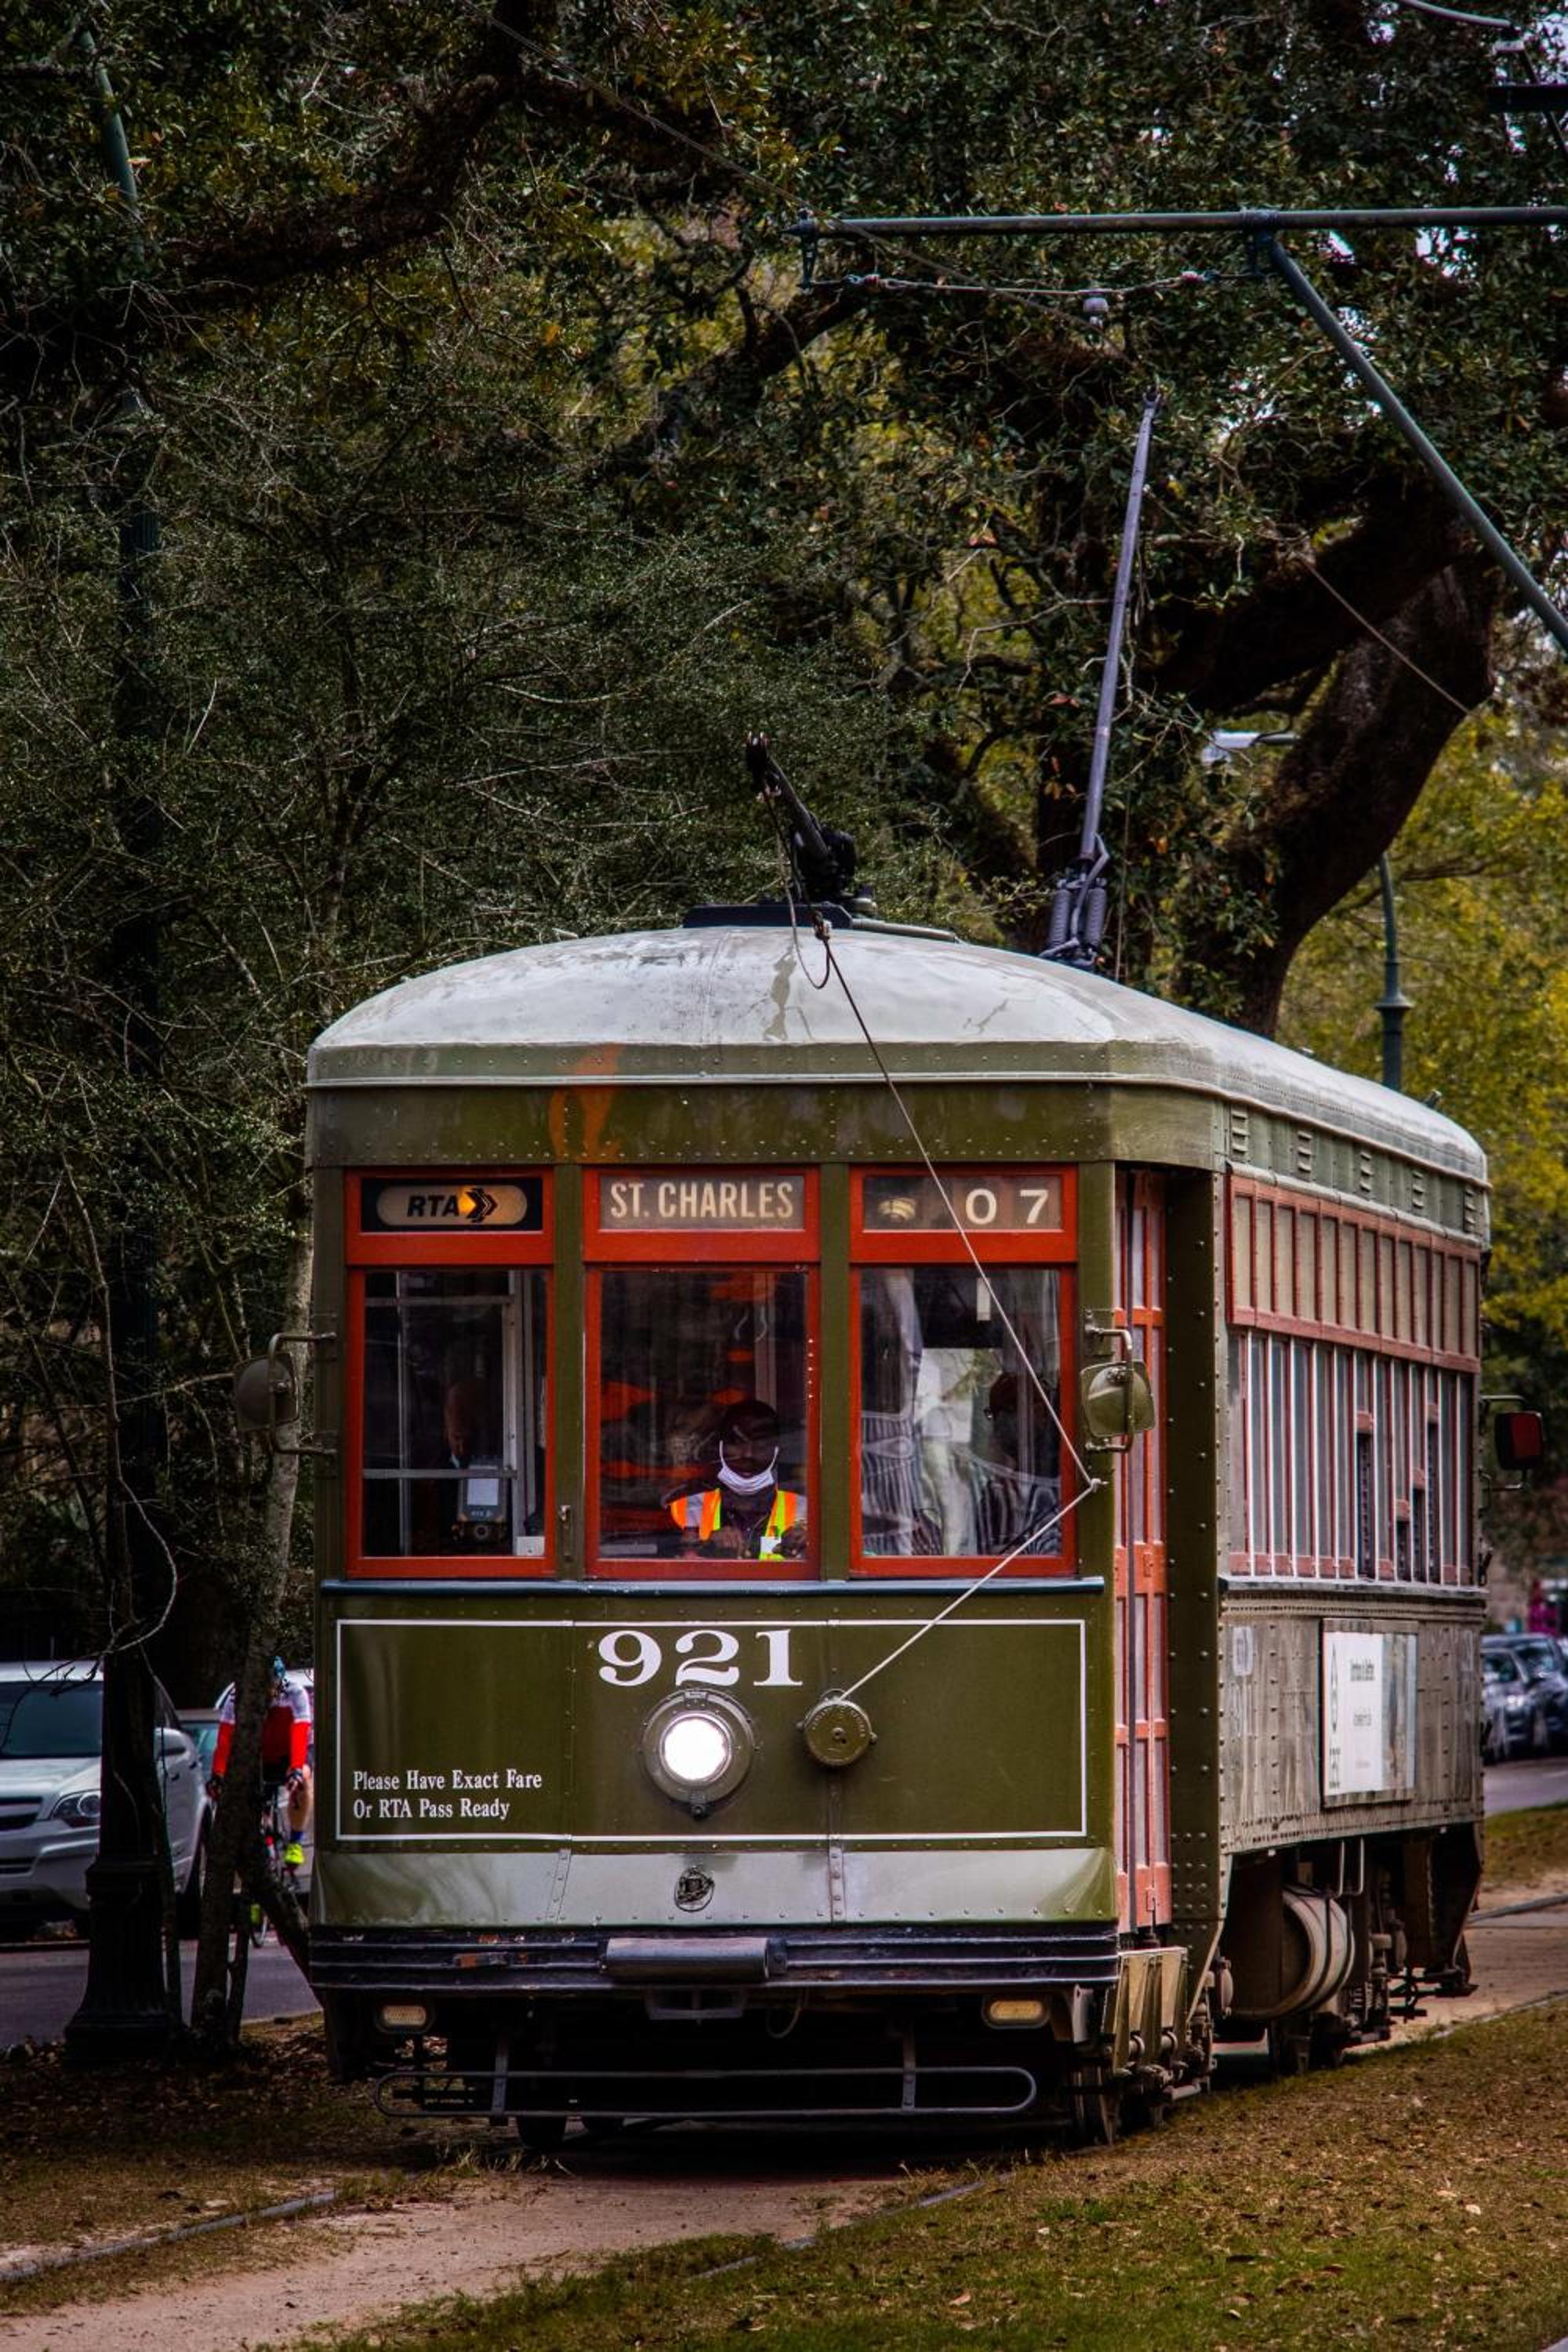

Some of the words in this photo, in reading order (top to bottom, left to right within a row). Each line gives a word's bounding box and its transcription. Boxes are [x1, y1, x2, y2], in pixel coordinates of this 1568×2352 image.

[406, 1194, 460, 1218] RTA
[610, 1181, 649, 1218] ST.
[657, 1181, 793, 1218] CHARLES
[598, 1629, 803, 1687] 921
[353, 1770, 401, 1791] Please
[406, 1769, 446, 1790] Have
[452, 1769, 499, 1789] Exact
[506, 1768, 543, 1789] Fare
[353, 1798, 373, 1819] Or
[379, 1798, 413, 1818] RTA
[419, 1798, 454, 1818] Pass
[459, 1797, 510, 1820] Ready
